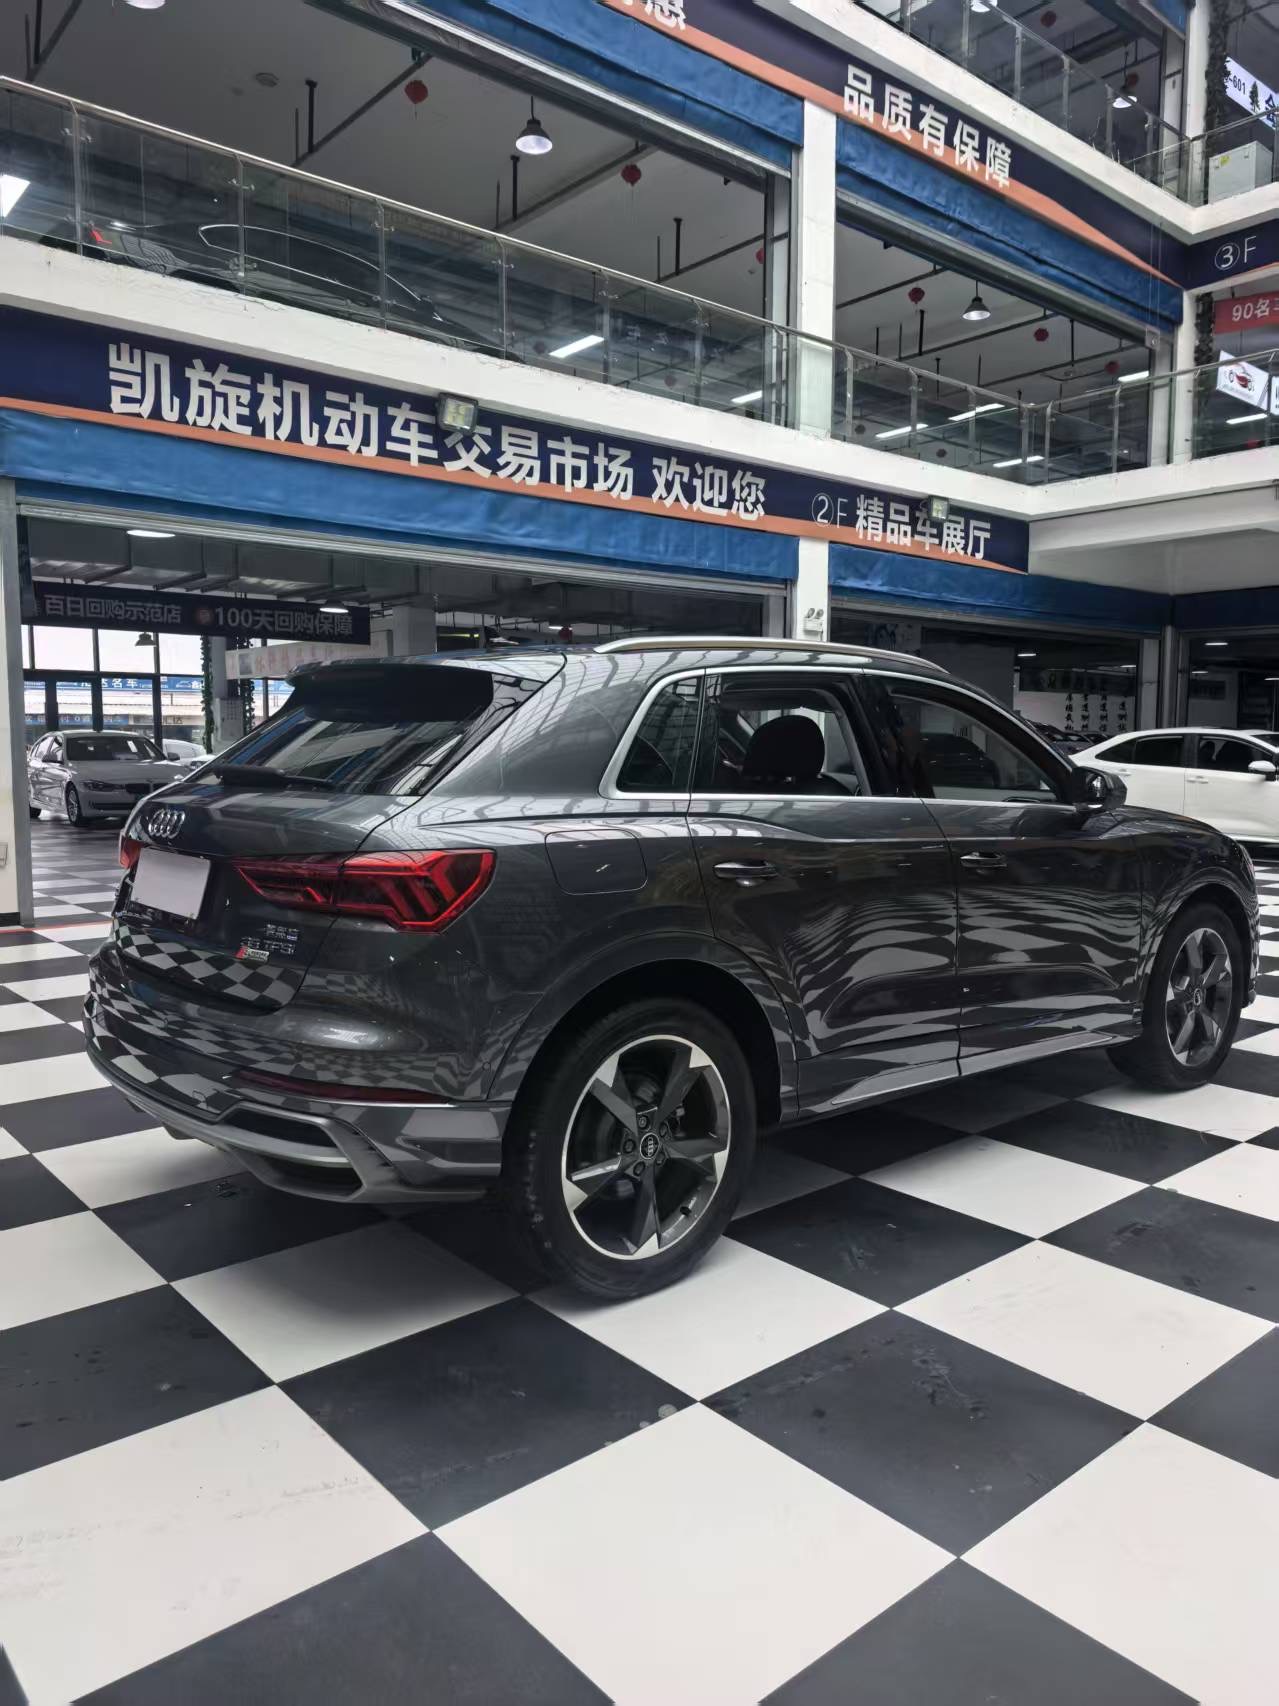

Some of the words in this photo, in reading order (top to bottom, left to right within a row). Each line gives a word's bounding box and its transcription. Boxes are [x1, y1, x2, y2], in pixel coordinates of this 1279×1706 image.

[843, 64, 1013, 189] 品质有保障
[1231, 299, 1279, 322] 90名
[108, 342, 635, 501] 凯旋机动车交易市场
[651, 456, 766, 522] 欢迎您
[855, 494, 991, 559] 精品车展厅
[44, 594, 182, 625] 百日回购示范店
[214, 605, 354, 636] 100天回购保障
